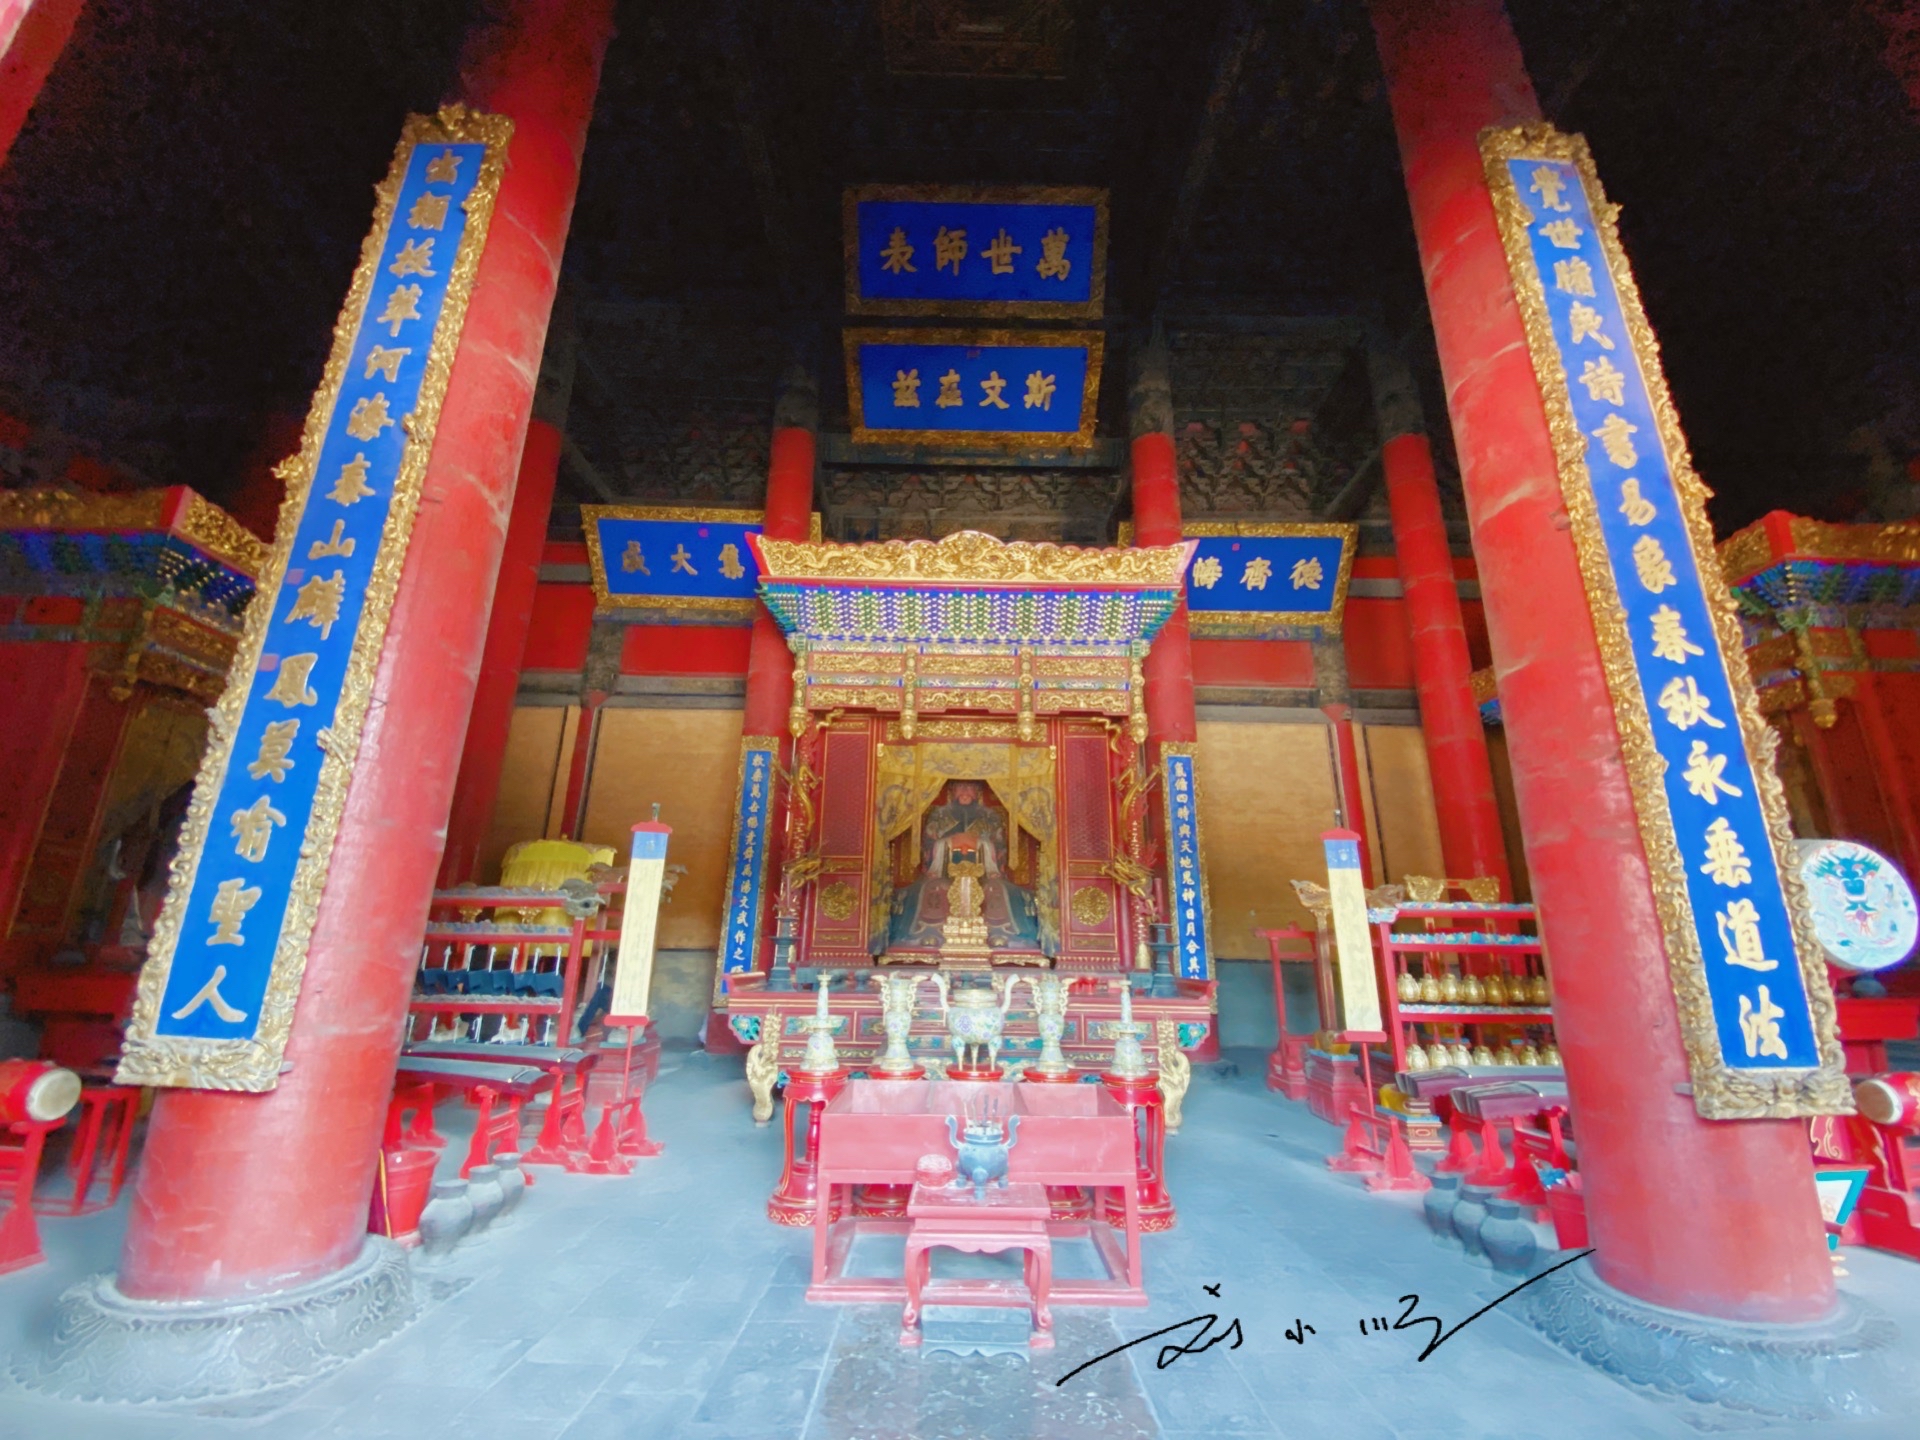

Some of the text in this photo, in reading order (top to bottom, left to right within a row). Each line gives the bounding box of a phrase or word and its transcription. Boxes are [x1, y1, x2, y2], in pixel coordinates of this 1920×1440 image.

[880, 225, 1071, 281] 萬世師表
[1174, 761, 1201, 980] 氣備四時與天地鬼神日月合其
